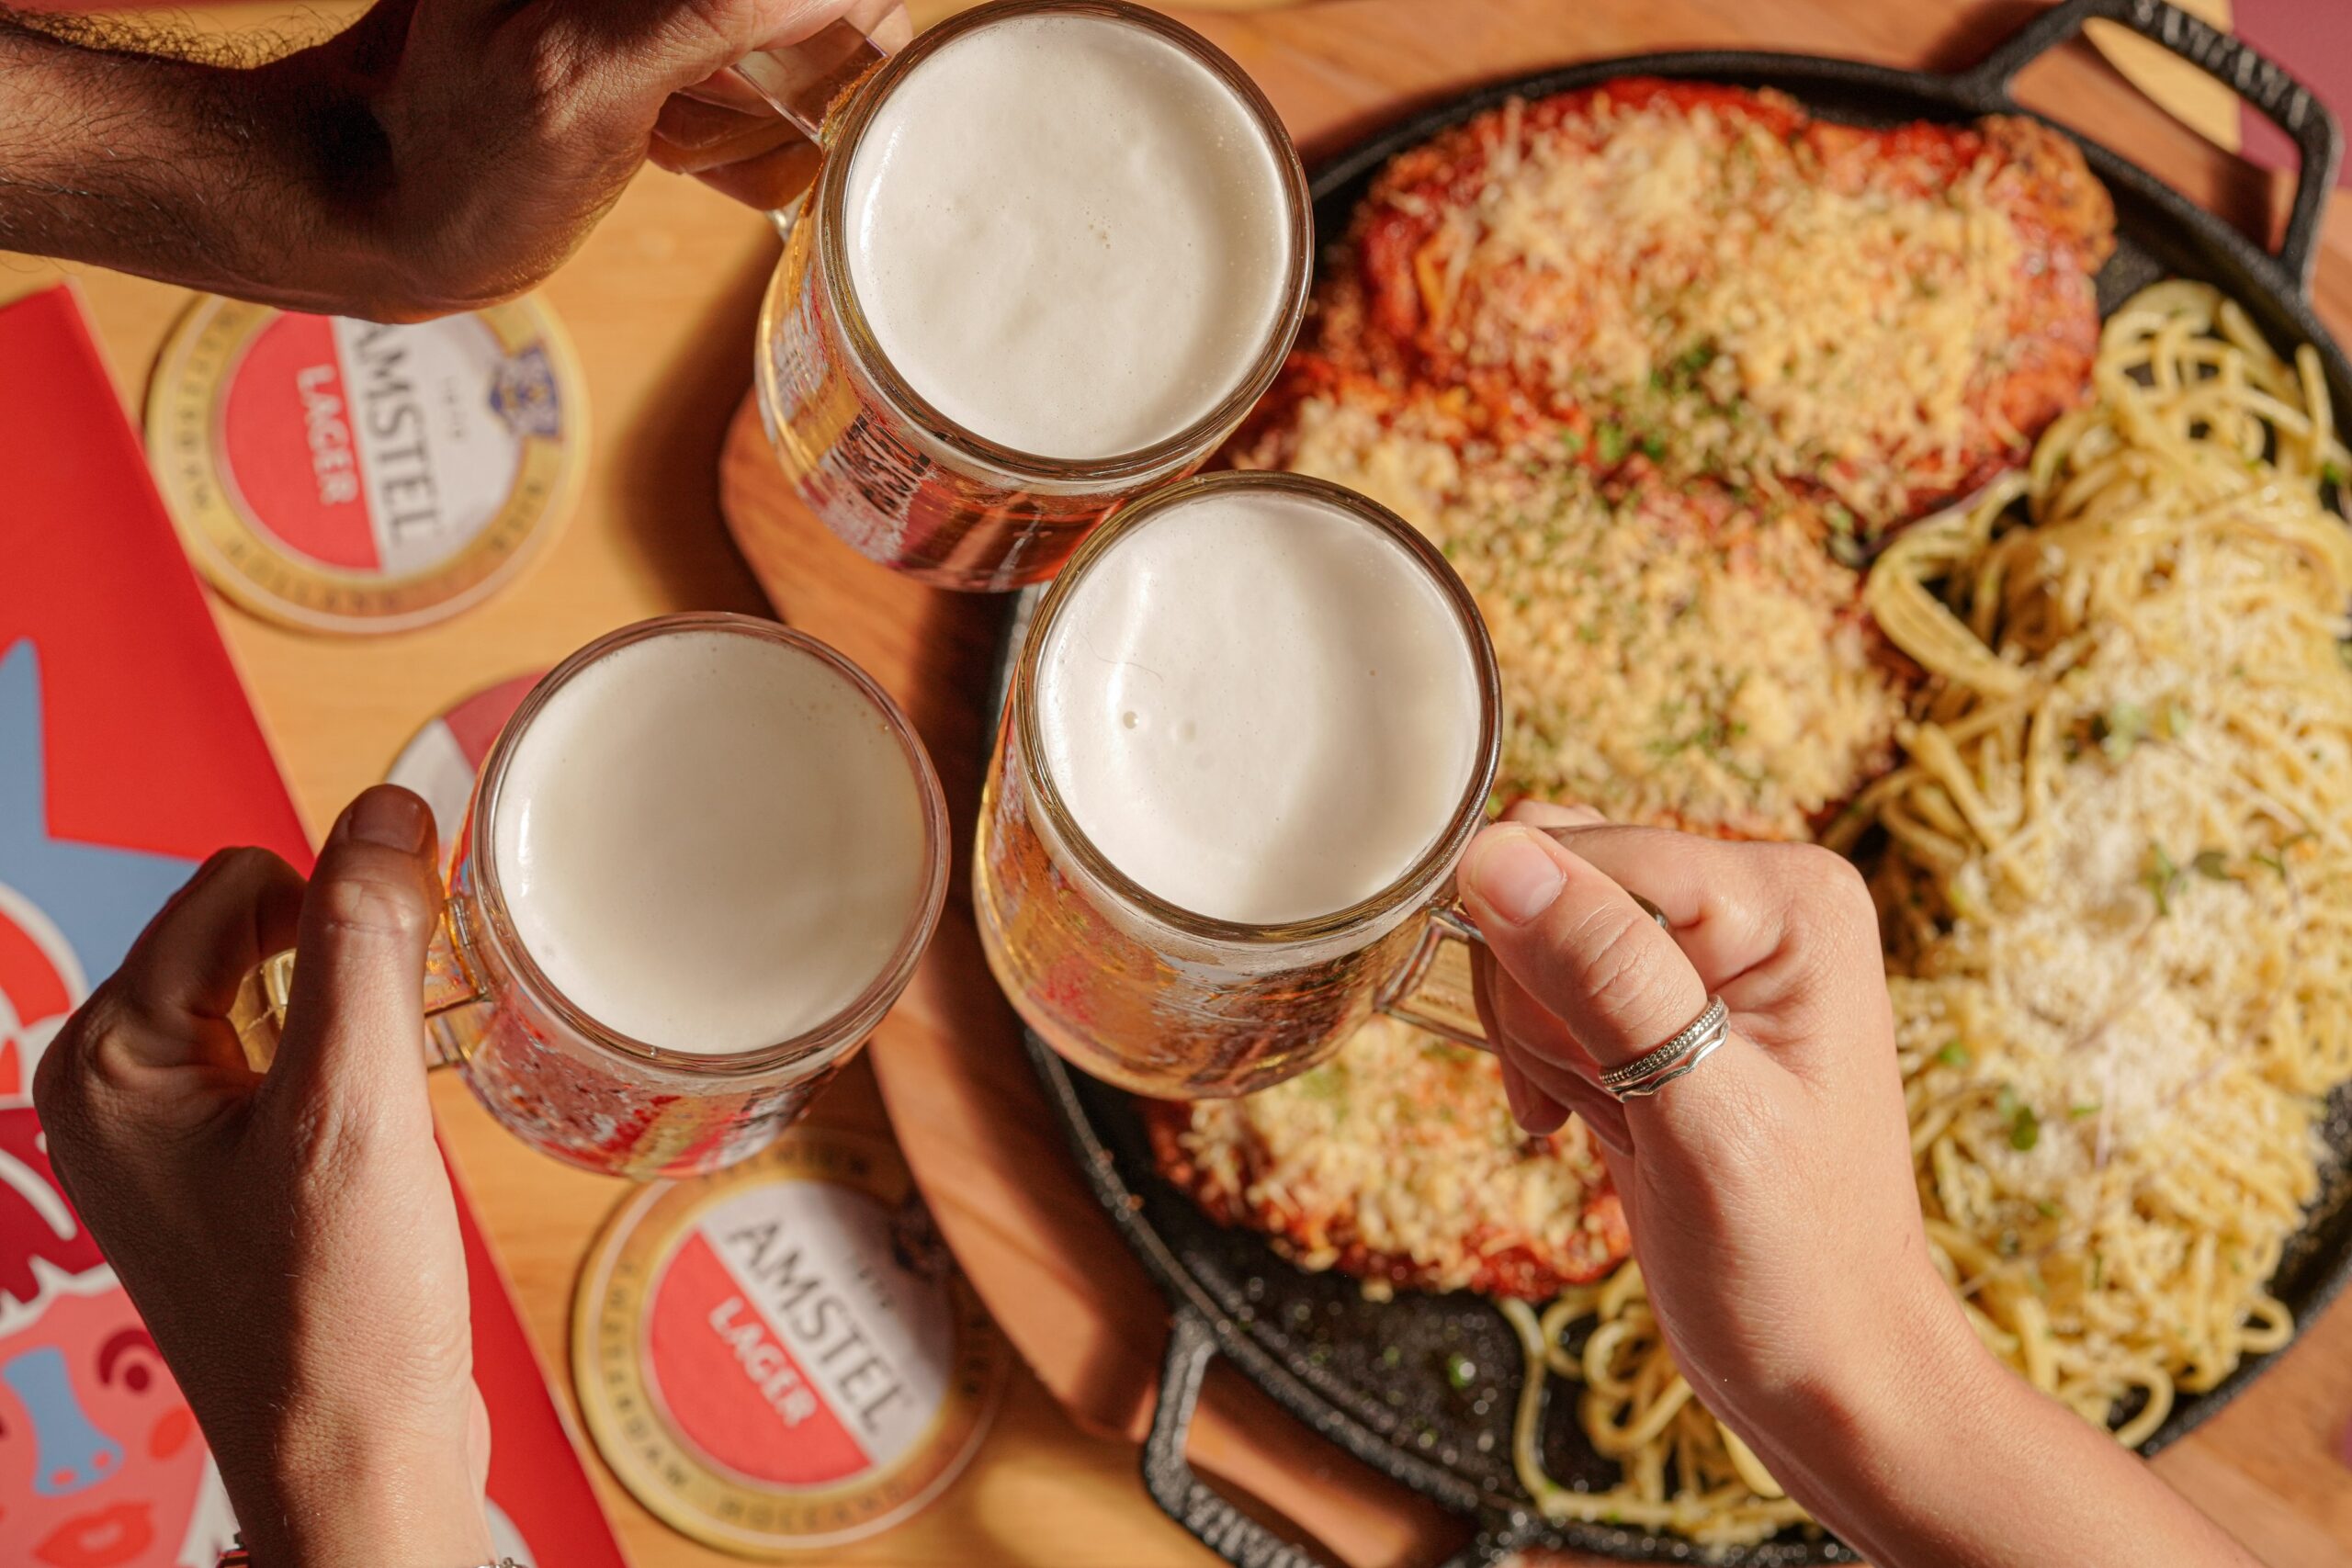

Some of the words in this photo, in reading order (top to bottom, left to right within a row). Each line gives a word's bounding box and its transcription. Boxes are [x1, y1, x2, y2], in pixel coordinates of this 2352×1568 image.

[295, 363, 358, 505] LAGER
[707, 1294, 818, 1429] LAGER
[725, 1219, 903, 1435] AMSTEL
